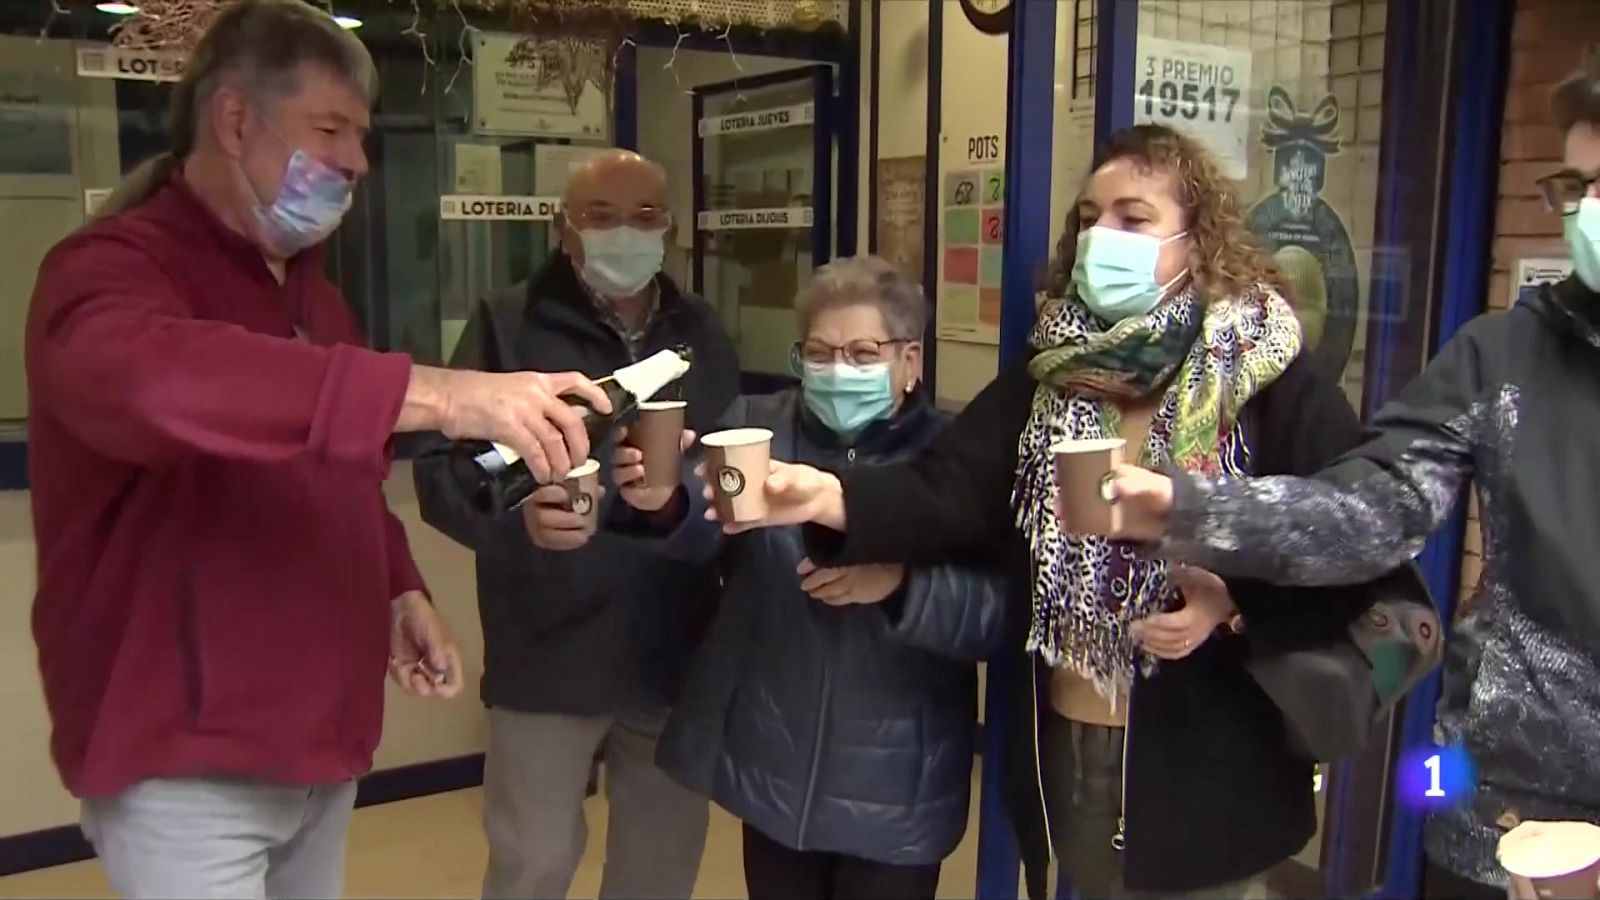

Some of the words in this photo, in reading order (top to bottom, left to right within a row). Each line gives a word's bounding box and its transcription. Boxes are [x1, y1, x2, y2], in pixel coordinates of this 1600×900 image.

[1145, 56, 1157, 77] 3
[1162, 59, 1235, 86] PREMIO
[1138, 79, 1241, 122] 19517
[757, 110, 791, 127] JUEVES
[968, 135, 999, 160] POTS
[461, 201, 534, 216] LOTERIA
